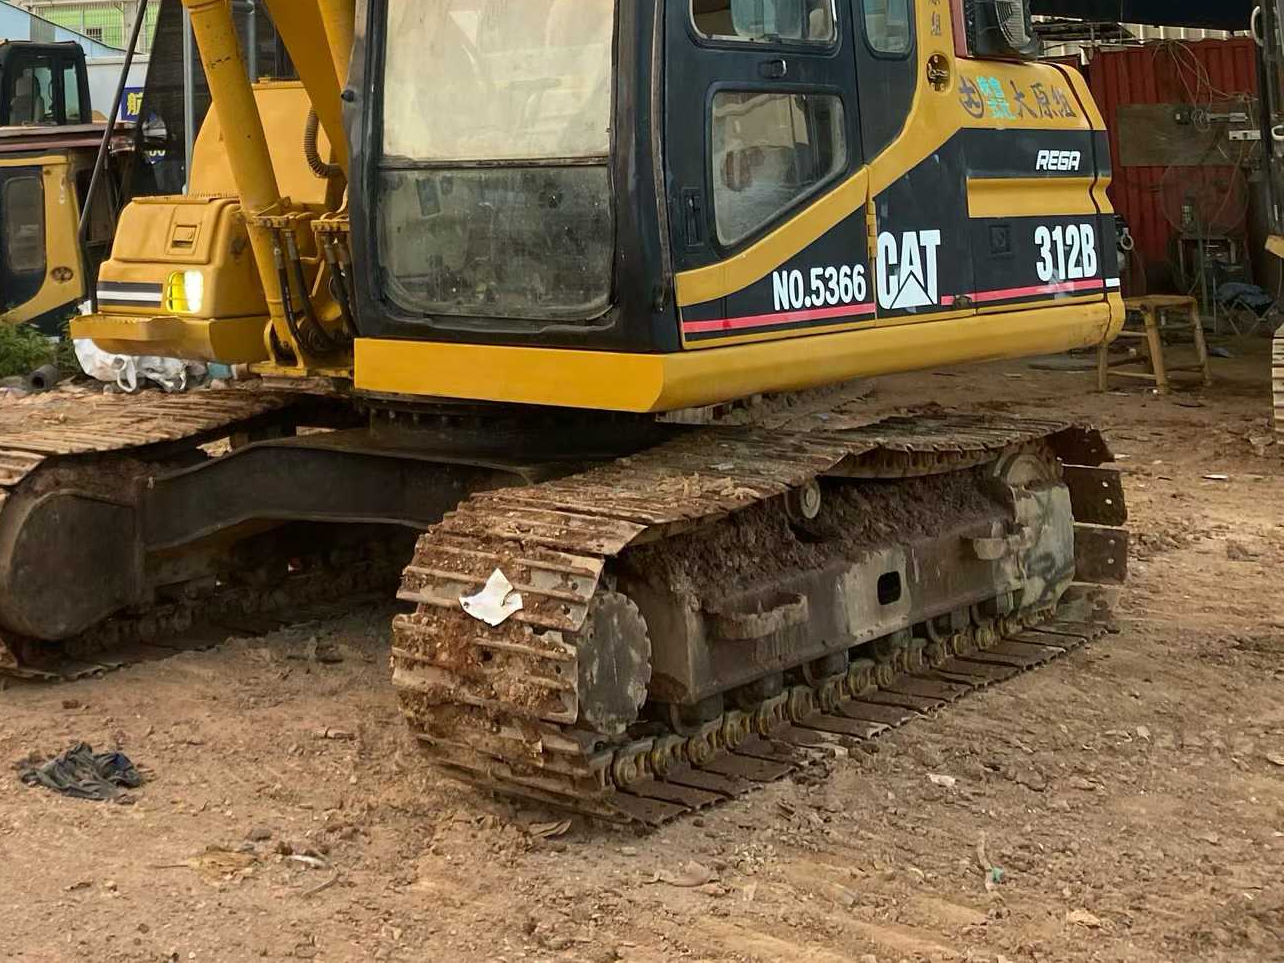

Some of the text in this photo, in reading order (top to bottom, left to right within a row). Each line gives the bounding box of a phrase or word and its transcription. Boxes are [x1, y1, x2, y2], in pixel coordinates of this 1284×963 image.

[1035, 150, 1081, 172] REGA
[772, 230, 941, 311] NO.5366 CAT
[1034, 223, 1097, 282] 312B
